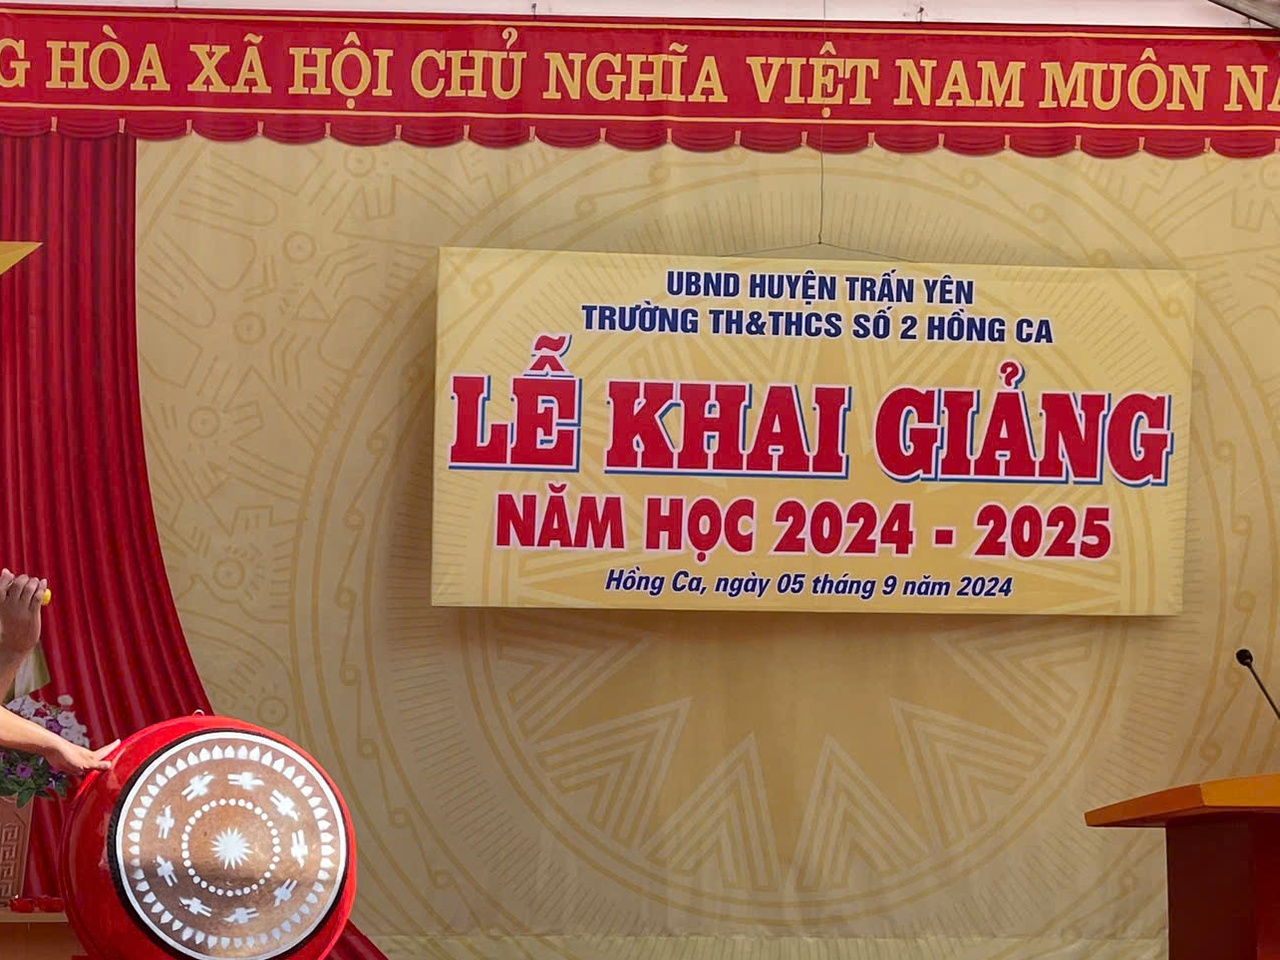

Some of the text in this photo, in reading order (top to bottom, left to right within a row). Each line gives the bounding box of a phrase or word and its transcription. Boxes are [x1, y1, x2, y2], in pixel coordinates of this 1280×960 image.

[47, 25, 171, 91] HÒA
[189, 33, 272, 94] XÃ
[289, 31, 394, 109] HỘI
[411, 27, 528, 100] CHỦ
[543, 42, 728, 103] NGHĨA
[746, 40, 880, 118] VIỆT
[894, 59, 1026, 108] NAM
[1040, 47, 1211, 111] MUÔN
[667, 267, 974, 306] UBND HUYỆN TRẤN YÊN
[581, 298, 1053, 344] TRƯỜNG TH&THCS SỐ 2 HỒNG CA
[449, 333, 1173, 486] LỄ KHAI GIẢNG
[495, 482, 1112, 562] NĂM HỌC 2024 - 2025
[605, 566, 1013, 600] Hồng Ca, ngày 05 tháng 9 năm 2024
